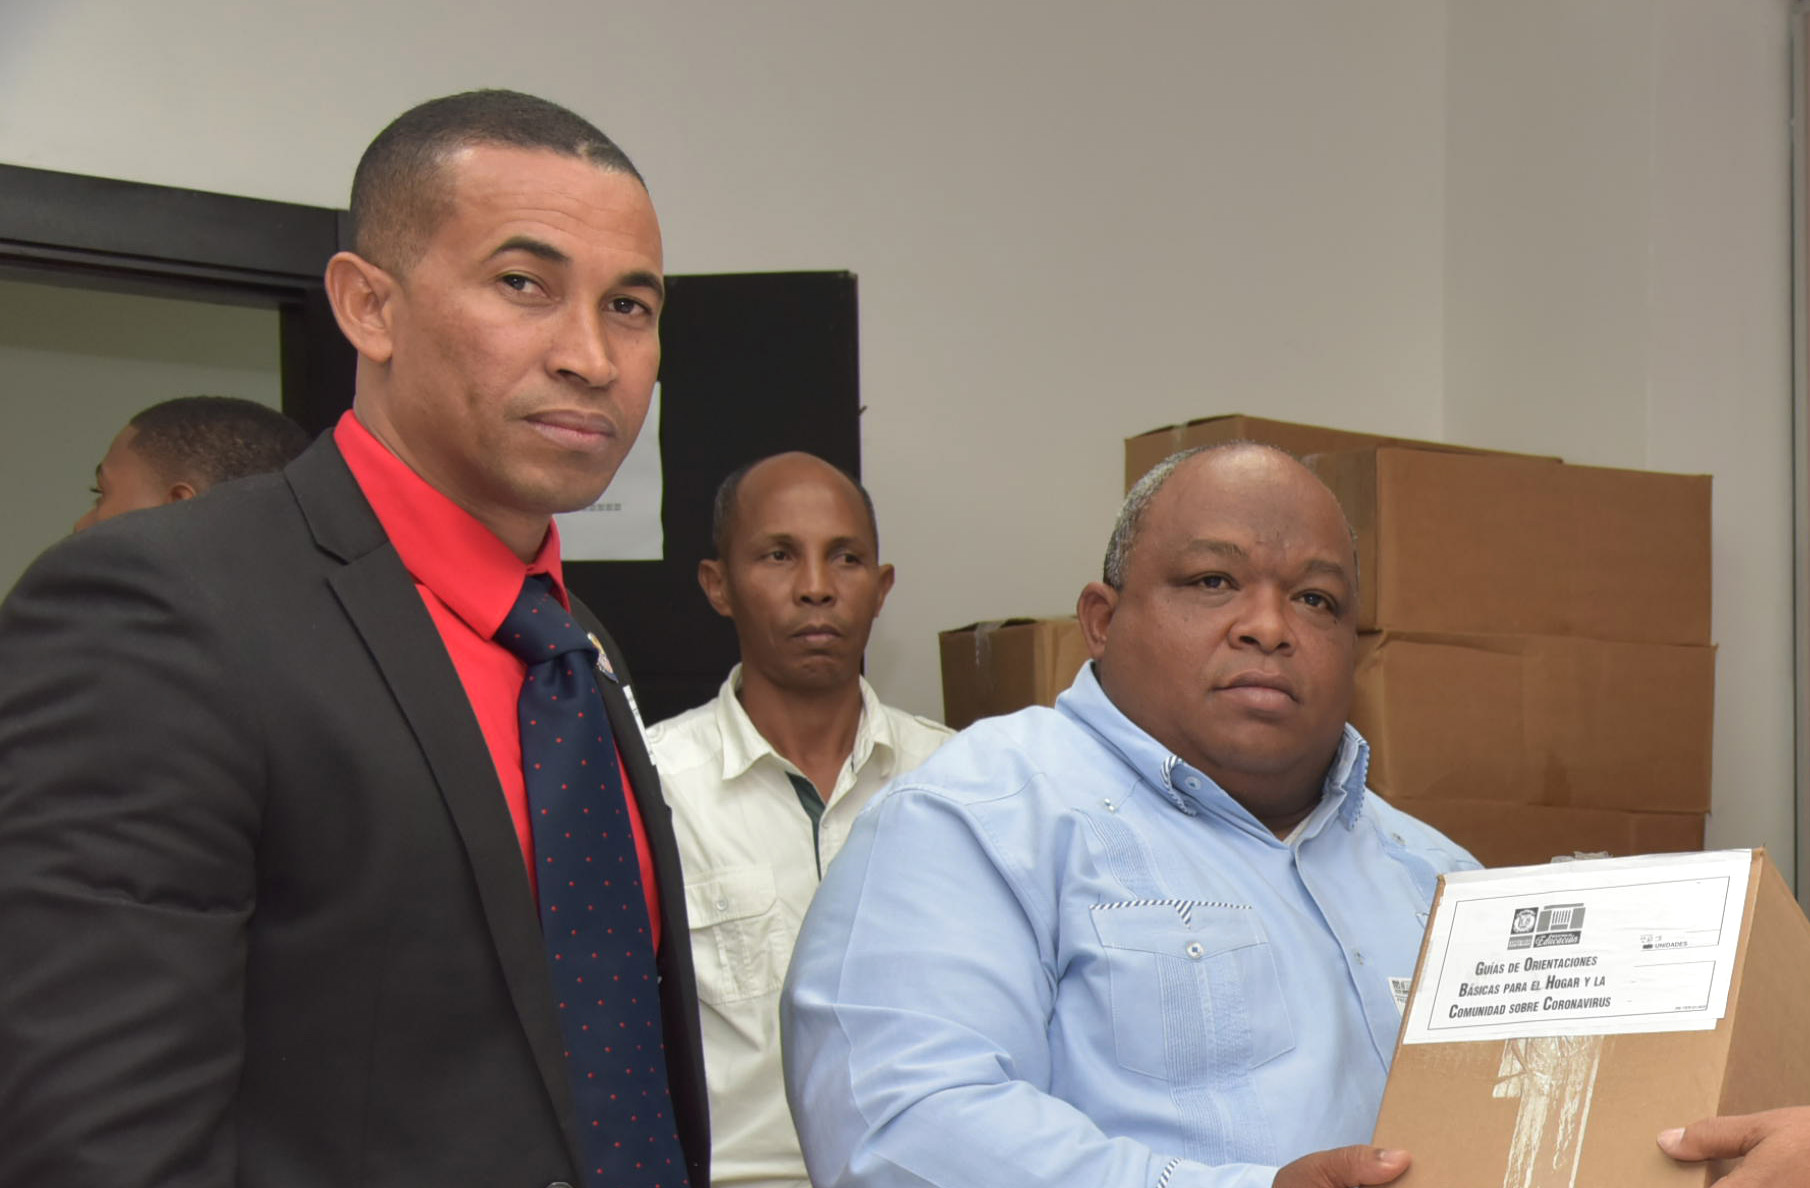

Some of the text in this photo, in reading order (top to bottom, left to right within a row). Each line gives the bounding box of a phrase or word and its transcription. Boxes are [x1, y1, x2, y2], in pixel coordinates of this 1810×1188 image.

[1655, 941, 1688, 949] UNIDADES
[1507, 962, 1520, 974] DE
[1524, 956, 1598, 972] ORIENTACIONES
[1503, 981, 1528, 994] PARA
[1530, 980, 1542, 991] EL
[1545, 975, 1580, 990] HOGAR
[1584, 976, 1591, 987] Y
[1593, 976, 1605, 987] LA
[1448, 996, 1612, 1019] COMUNIDAD SOBRE CORONAVIRUS
